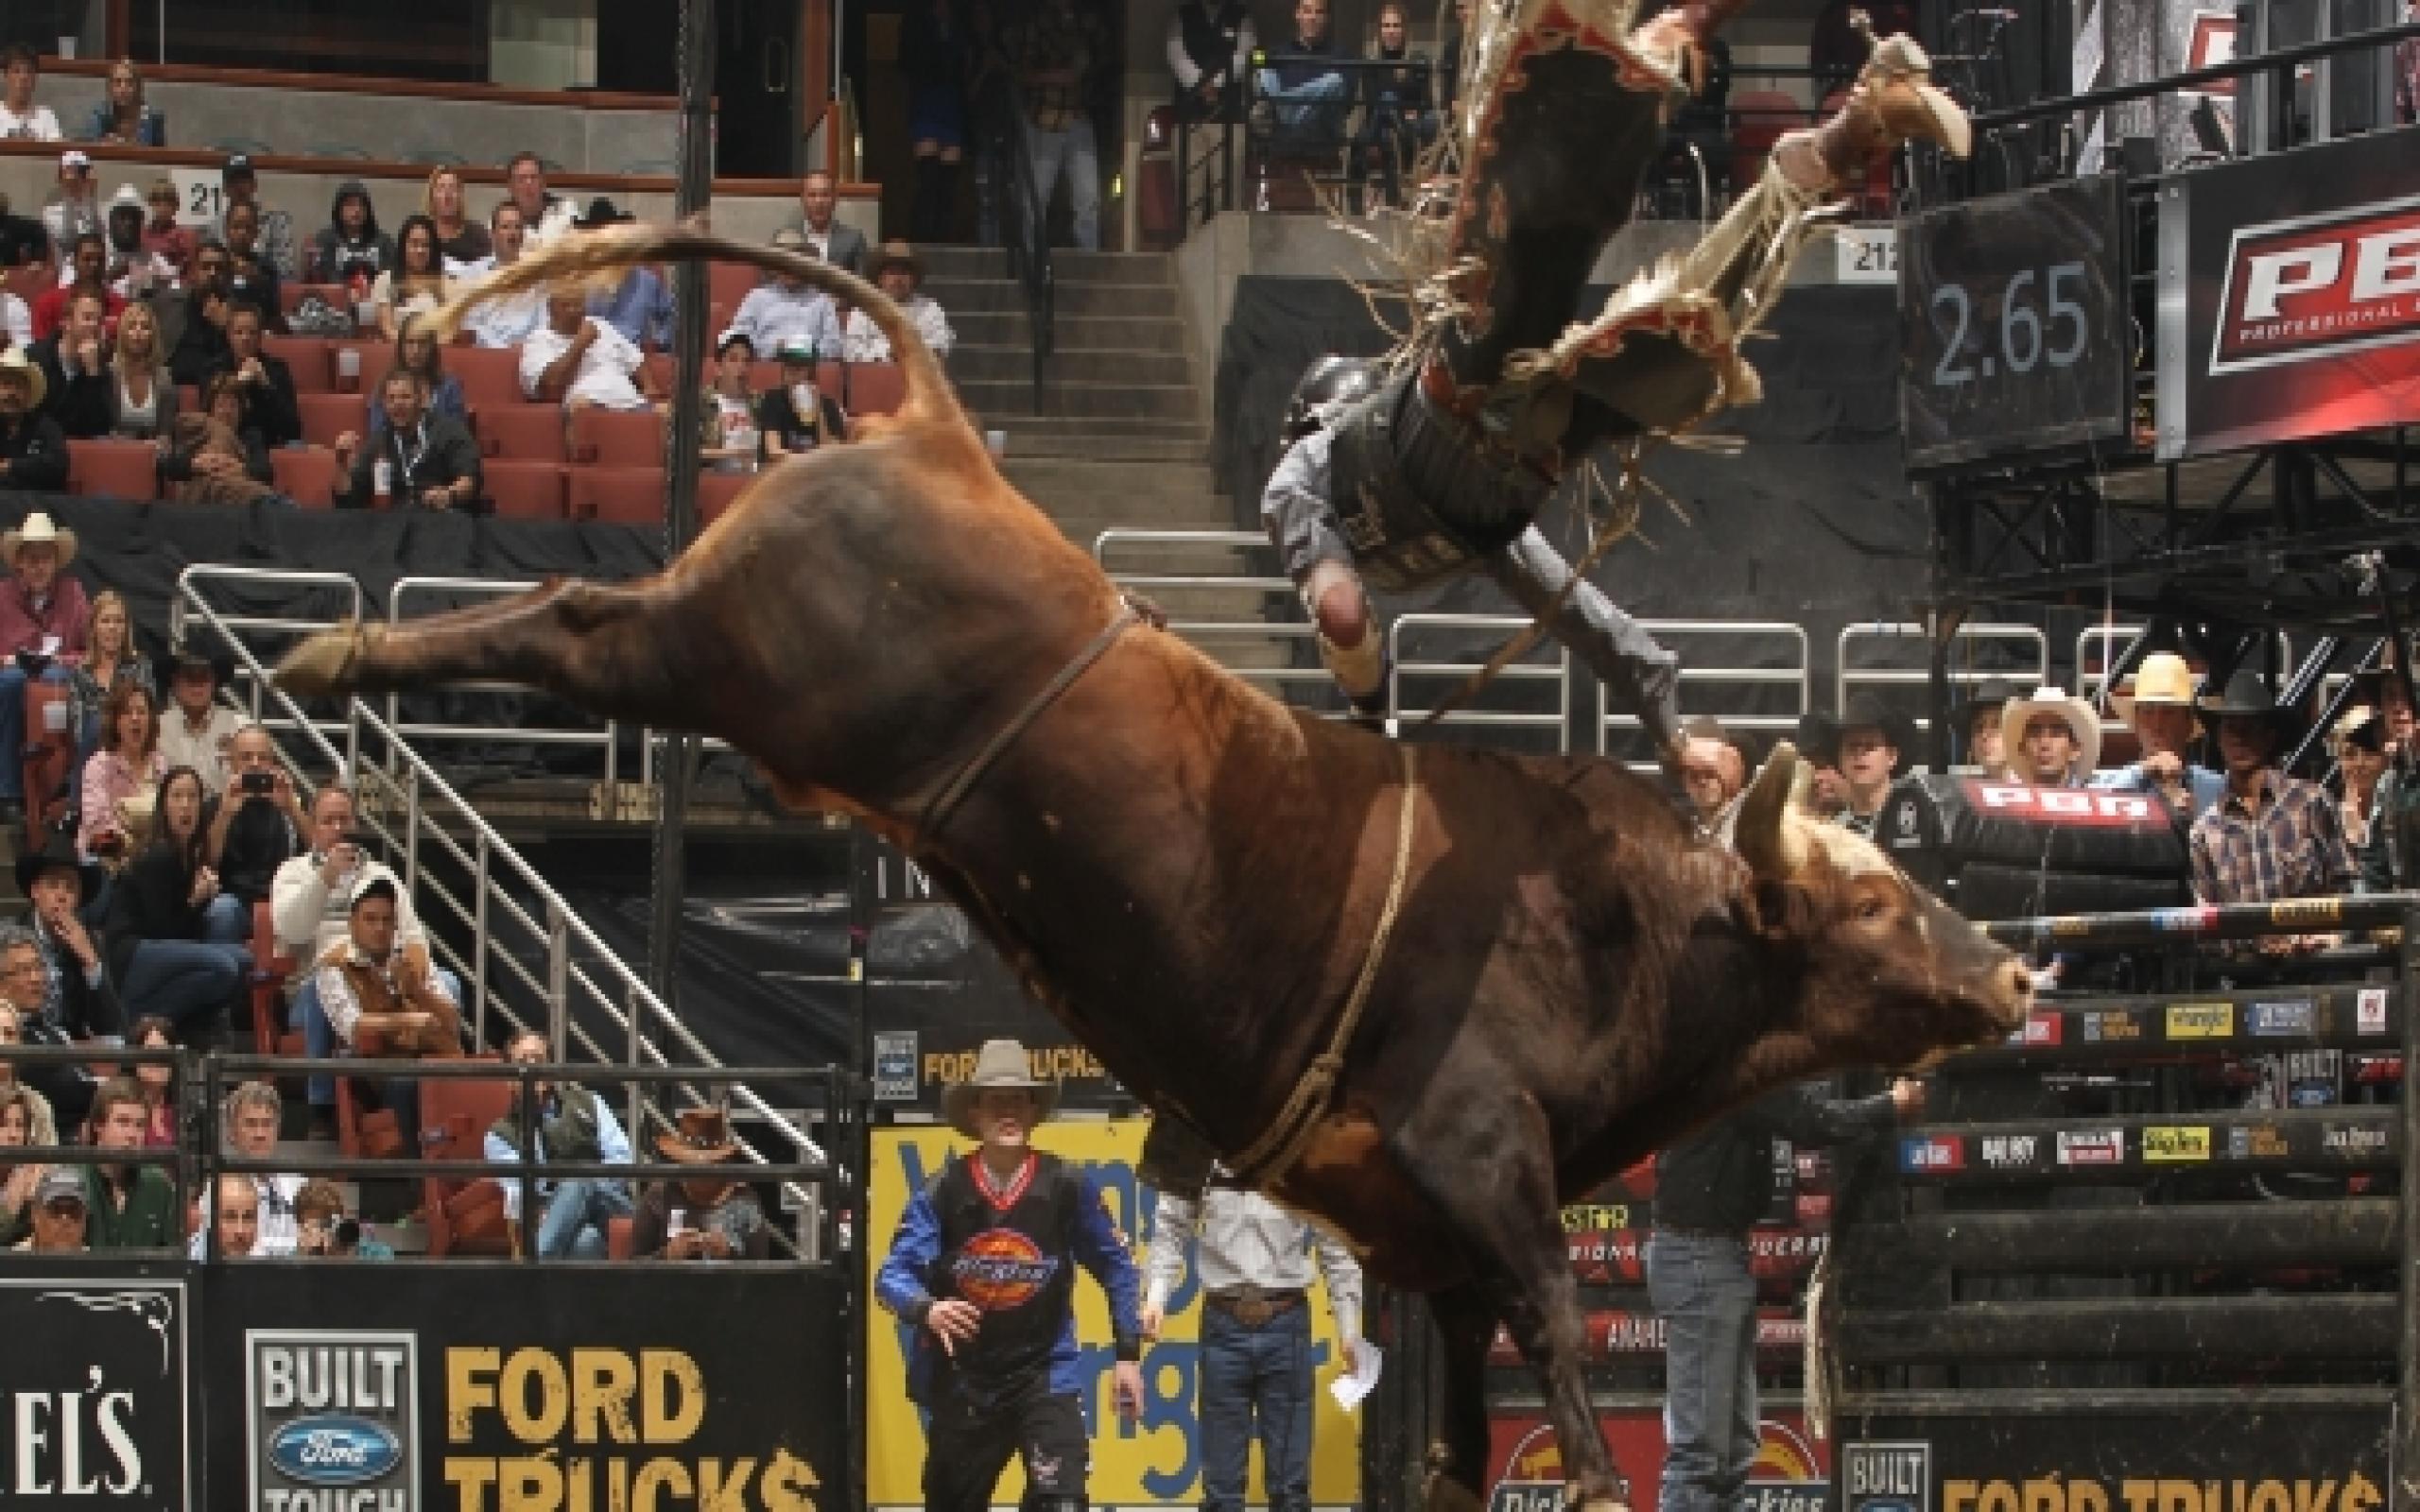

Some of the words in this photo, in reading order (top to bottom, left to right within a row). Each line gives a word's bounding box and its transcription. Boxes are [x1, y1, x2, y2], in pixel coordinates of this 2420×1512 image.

[190, 183, 222, 215] 21
[1931, 261, 2088, 387] 2.65
[2239, 301, 2402, 344] PROFESSIONAL
[1981, 786, 2149, 816] PBR
[924, 1051, 979, 1085] FOR
[262, 1347, 403, 1407] BUILT
[445, 1347, 707, 1444] FORD
[0, 1365, 141, 1494] EL'S
[444, 1452, 821, 1512] TRUCKS
[1853, 1452, 1922, 1495] BUILT
